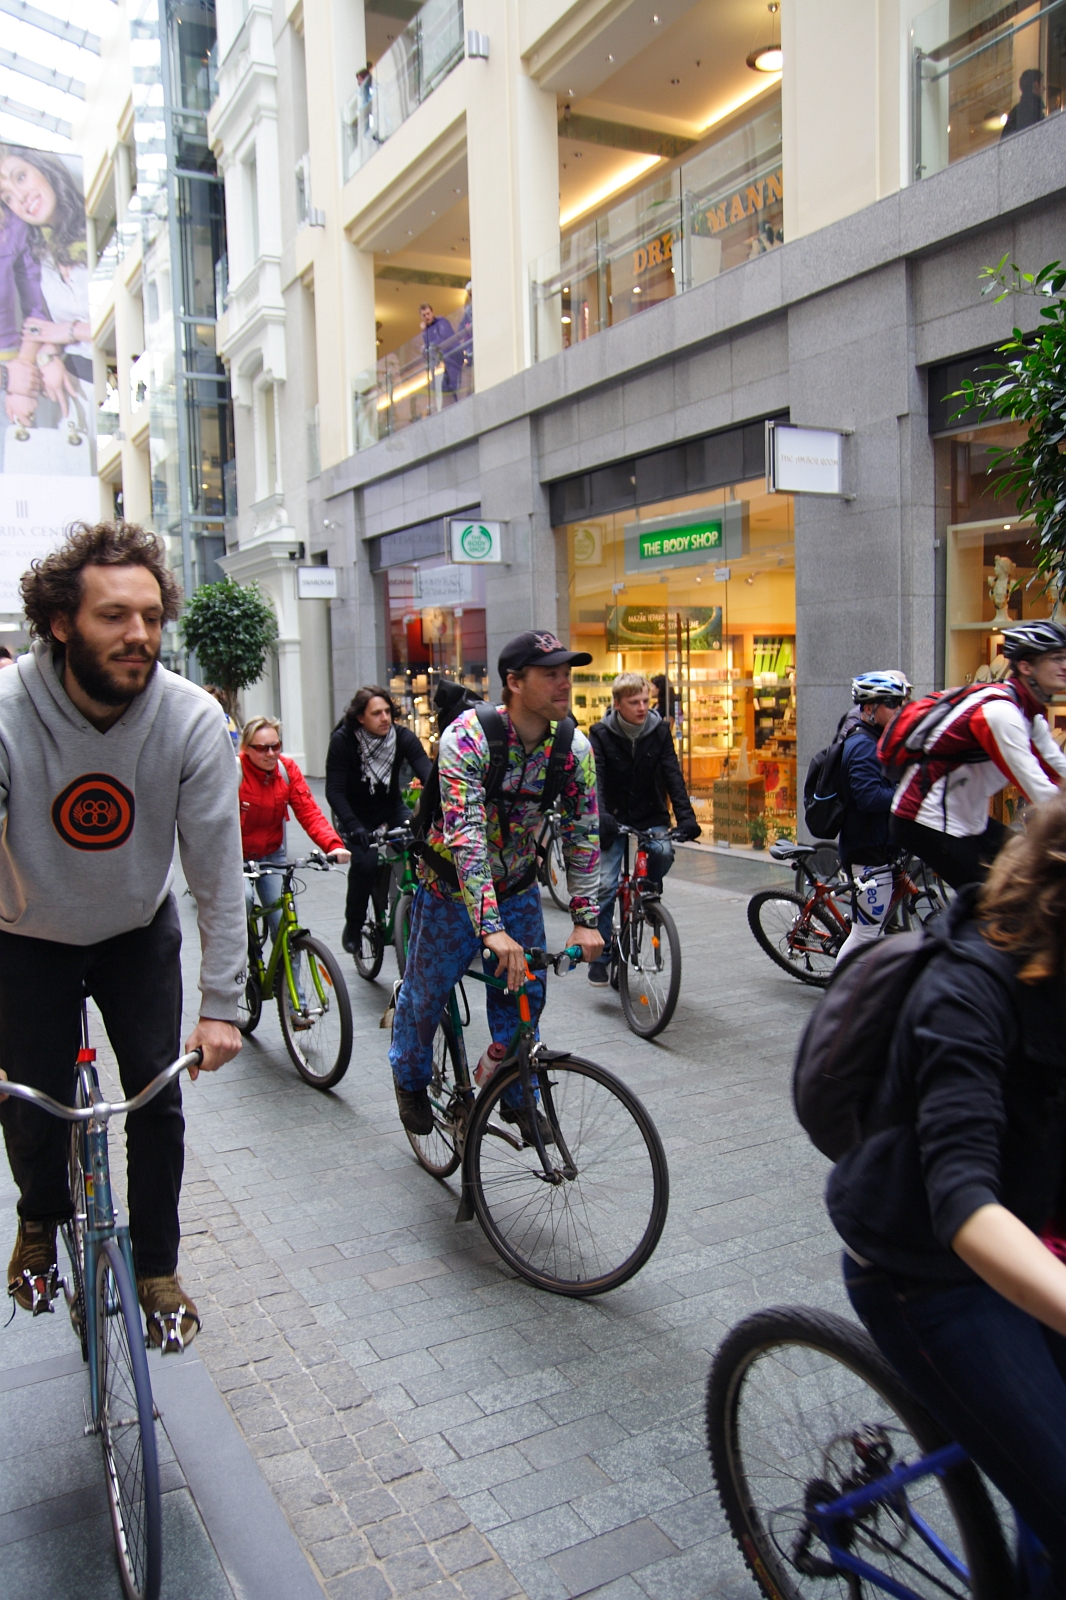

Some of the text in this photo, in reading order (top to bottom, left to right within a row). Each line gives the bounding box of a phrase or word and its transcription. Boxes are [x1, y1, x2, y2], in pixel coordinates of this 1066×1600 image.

[643, 530, 718, 557] THE BODY SHOP
